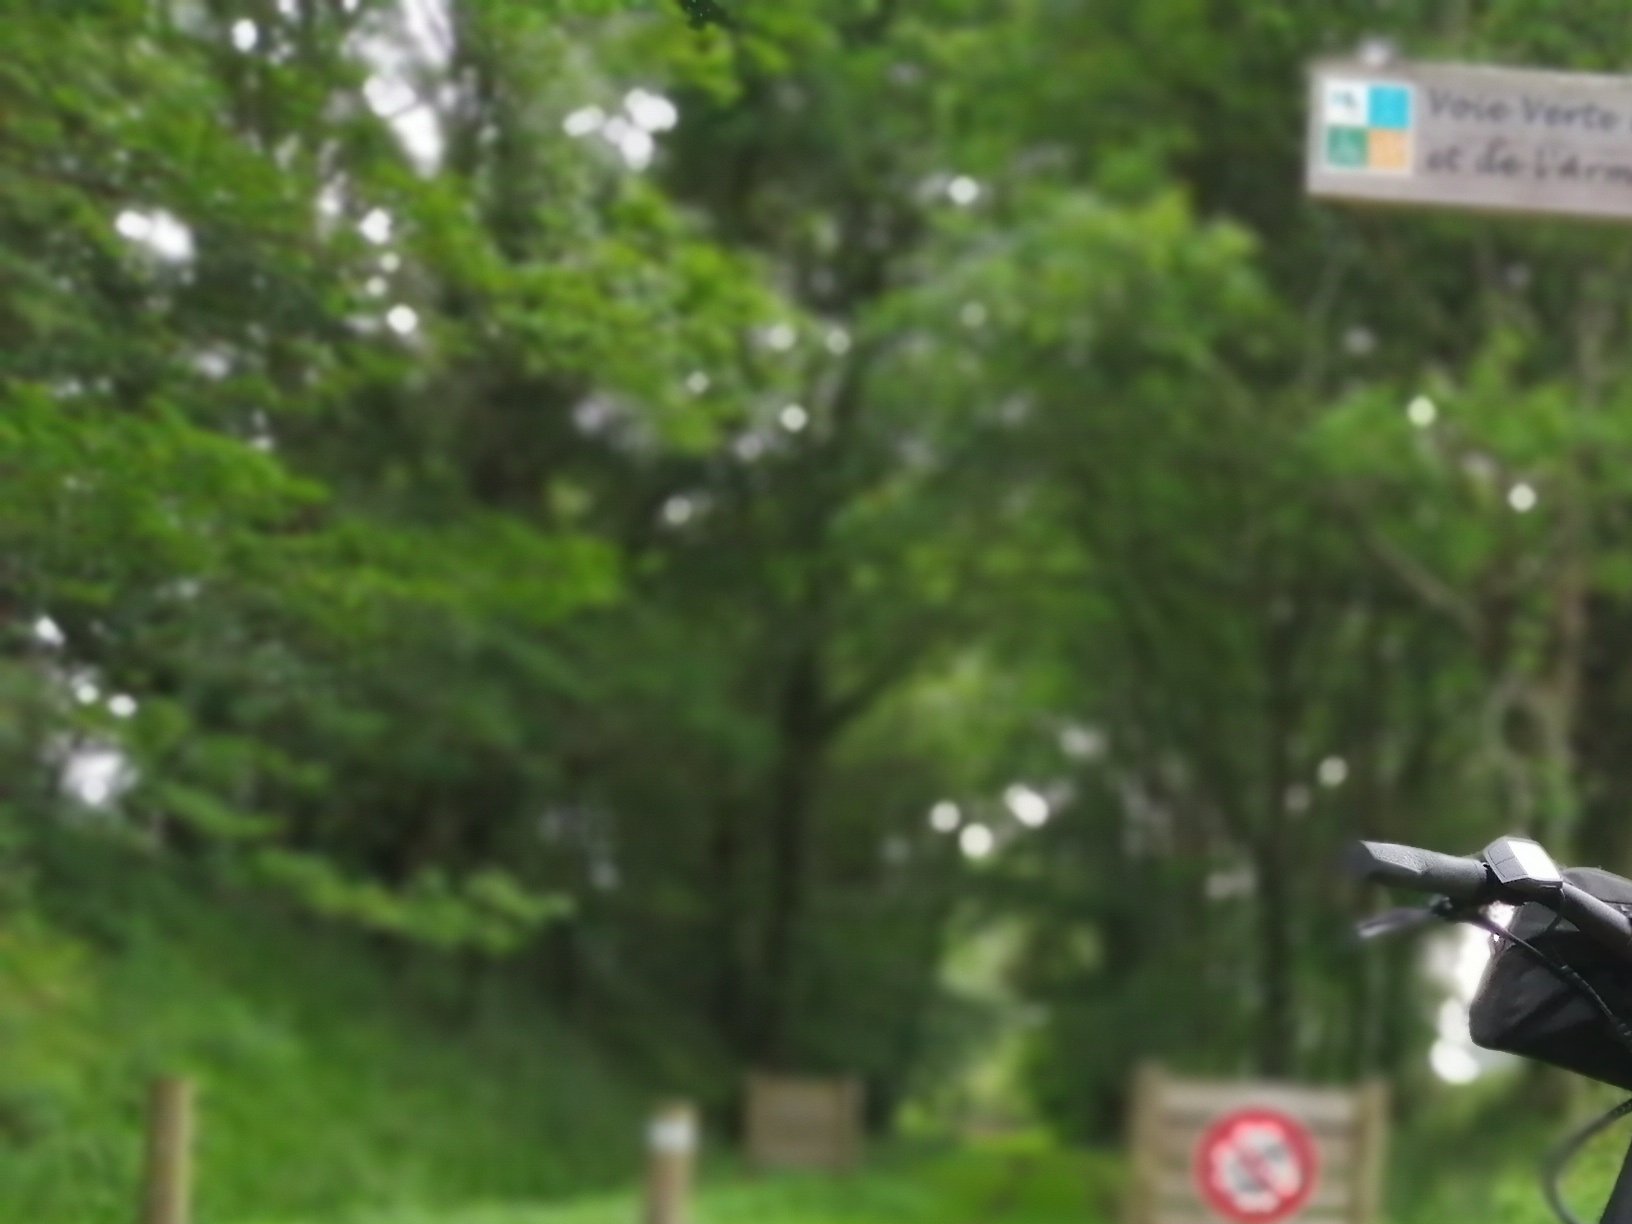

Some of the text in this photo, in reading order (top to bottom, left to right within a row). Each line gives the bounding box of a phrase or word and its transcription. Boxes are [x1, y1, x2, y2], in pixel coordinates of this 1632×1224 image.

[1429, 88, 1513, 124] Voie
[1523, 96, 1620, 132] Verte
[1426, 143, 1463, 174] et
[1476, 138, 1522, 177] de
